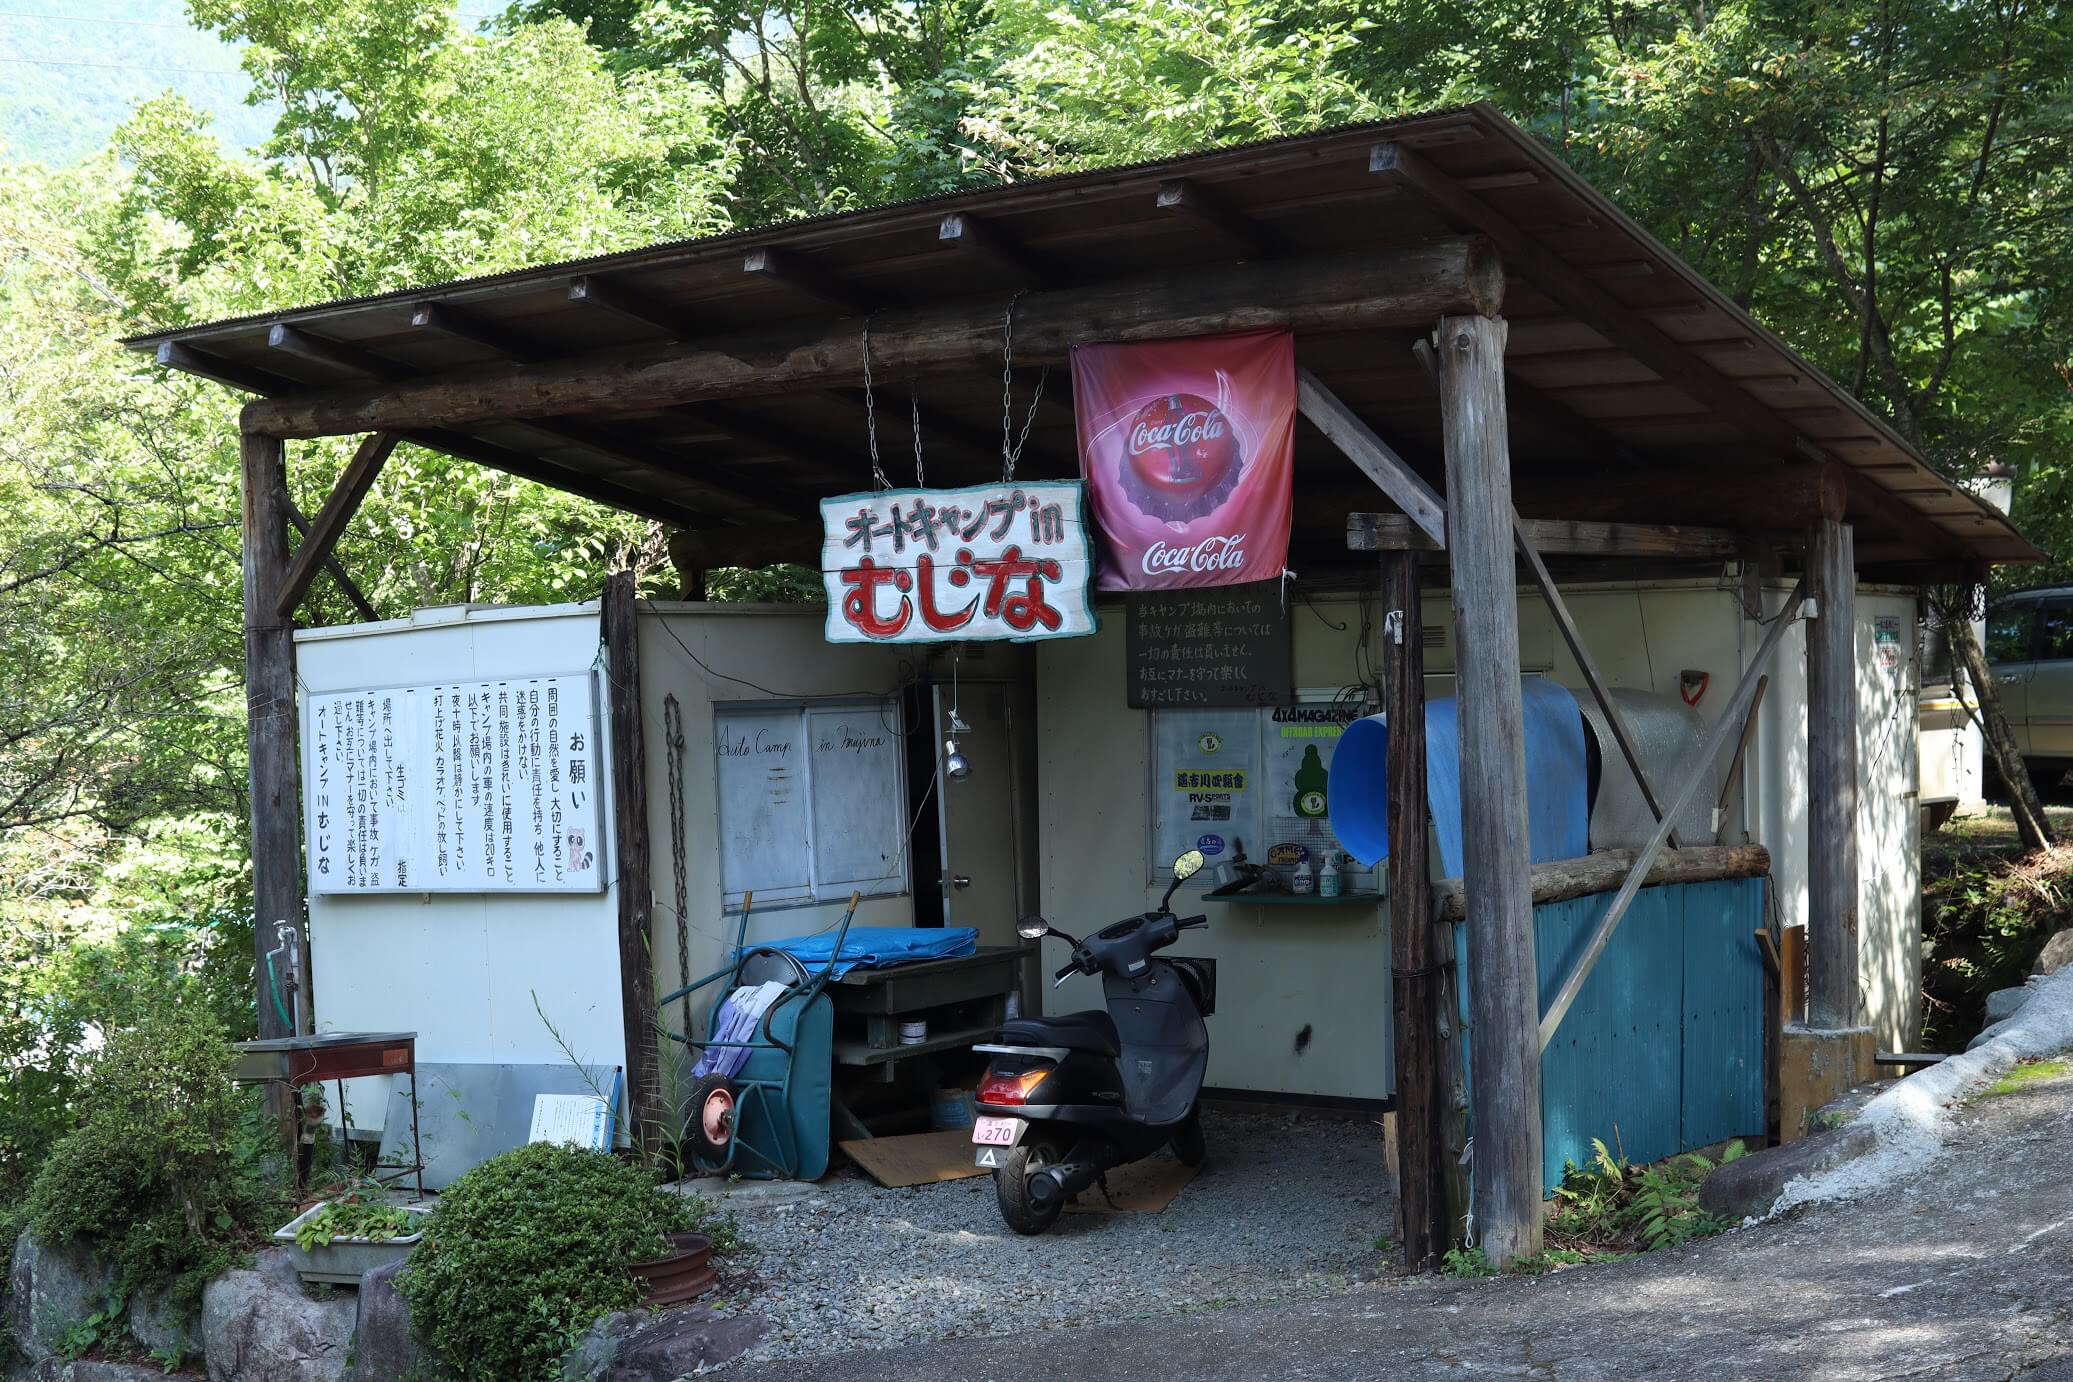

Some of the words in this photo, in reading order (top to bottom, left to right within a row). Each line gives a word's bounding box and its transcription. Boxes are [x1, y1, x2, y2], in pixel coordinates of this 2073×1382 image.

[1128, 408, 1224, 456] Coca-Cola
[1141, 532, 1247, 576] Coca-Cola
[840, 544, 1064, 639] むじな
[755, 728, 792, 759] Camp
[816, 737, 835, 752] in
[568, 731, 586, 810] お願い
[985, 1127, 1011, 1142] 270
